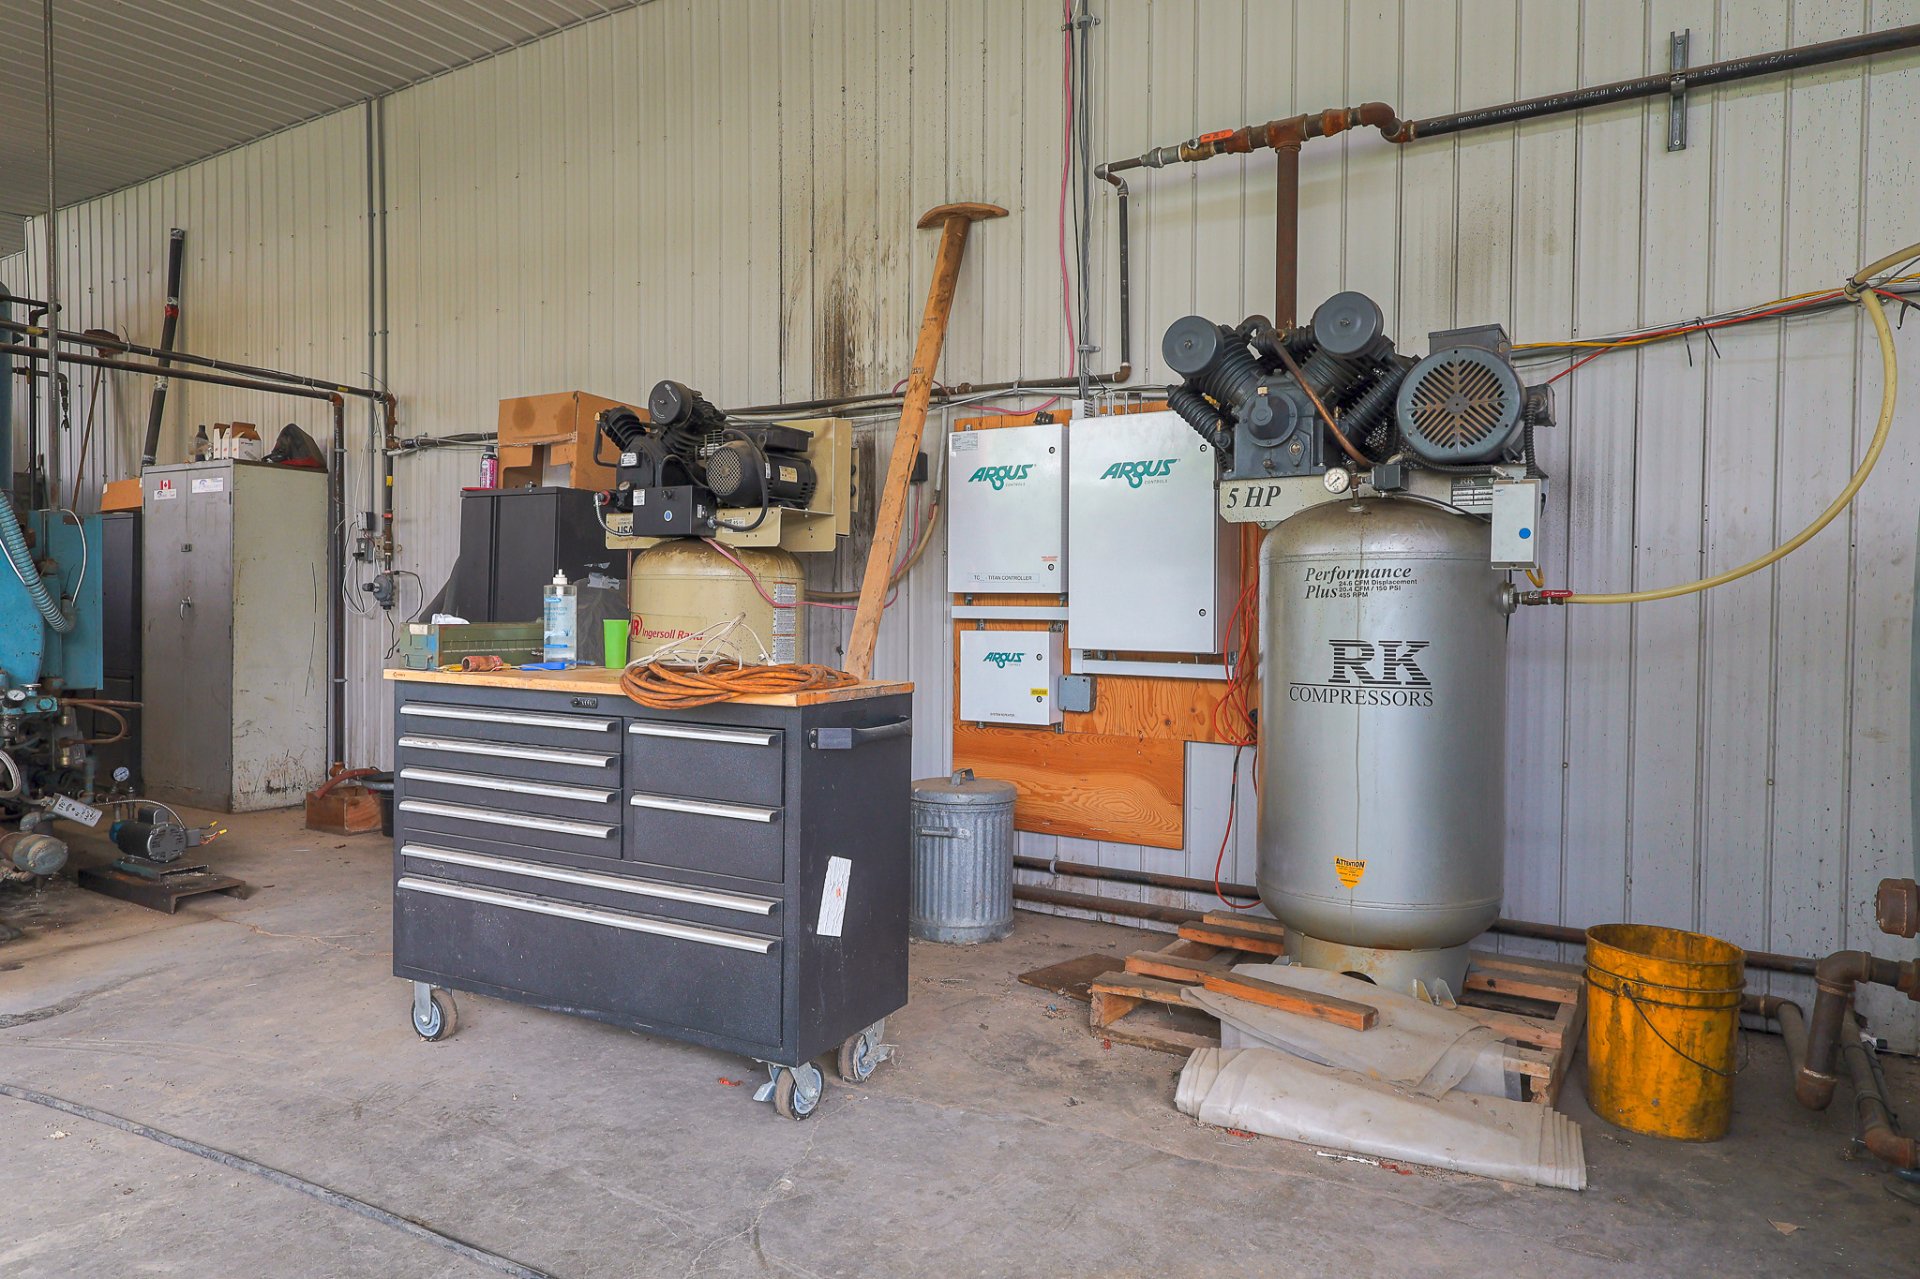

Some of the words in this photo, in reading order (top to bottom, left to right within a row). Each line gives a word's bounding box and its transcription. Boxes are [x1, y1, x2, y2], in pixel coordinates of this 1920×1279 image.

[968, 464, 1033, 490] ARGUS
[1100, 459, 1177, 488] ARGUS
[1226, 488, 1239, 508] 5
[1243, 485, 1282, 507] HP
[1304, 566, 1412, 584] Performance
[1305, 585, 1338, 599] Plus
[642, 627, 676, 639] Ingersoll
[983, 652, 1025, 668] ARGUS
[1328, 639, 1432, 686] RK
[1289, 686, 1433, 707] COMPRESSORS
[1336, 858, 1366, 868] ATTENTION
